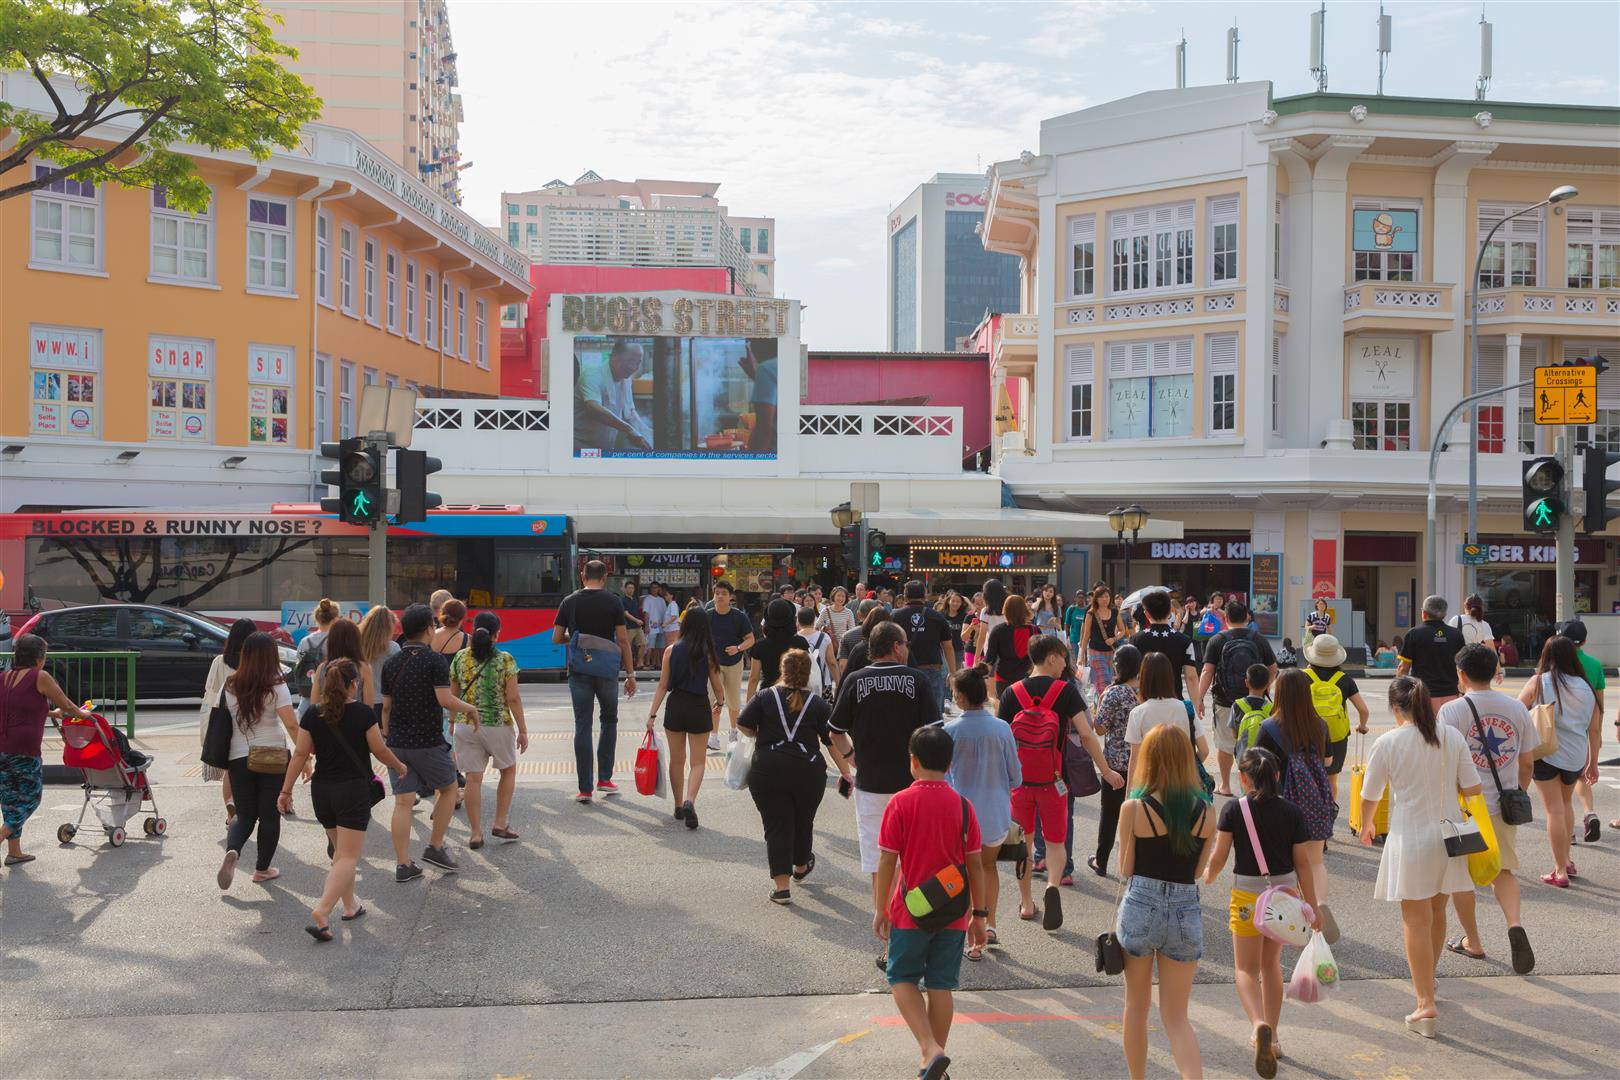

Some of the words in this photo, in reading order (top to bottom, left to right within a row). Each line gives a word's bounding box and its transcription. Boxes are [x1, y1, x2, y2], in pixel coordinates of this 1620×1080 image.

[562, 295, 663, 334] BUGIS
[672, 297, 790, 336] STREET
[1361, 345, 1401, 359] ZEAL
[1544, 369, 1586, 377] Alternative
[1546, 377, 1583, 387] Crossings
[1115, 389, 1146, 401] ZEAL
[1158, 388, 1190, 399] ZEAL
[32, 520, 135, 534] BLOCKED
[143, 519, 158, 534] &
[166, 520, 242, 534] RUNNY
[1151, 542, 1222, 559] BURGER
[1227, 543, 1251, 558] KI
[1488, 545, 1524, 562] GER
[287, 609, 312, 628] Zyr
